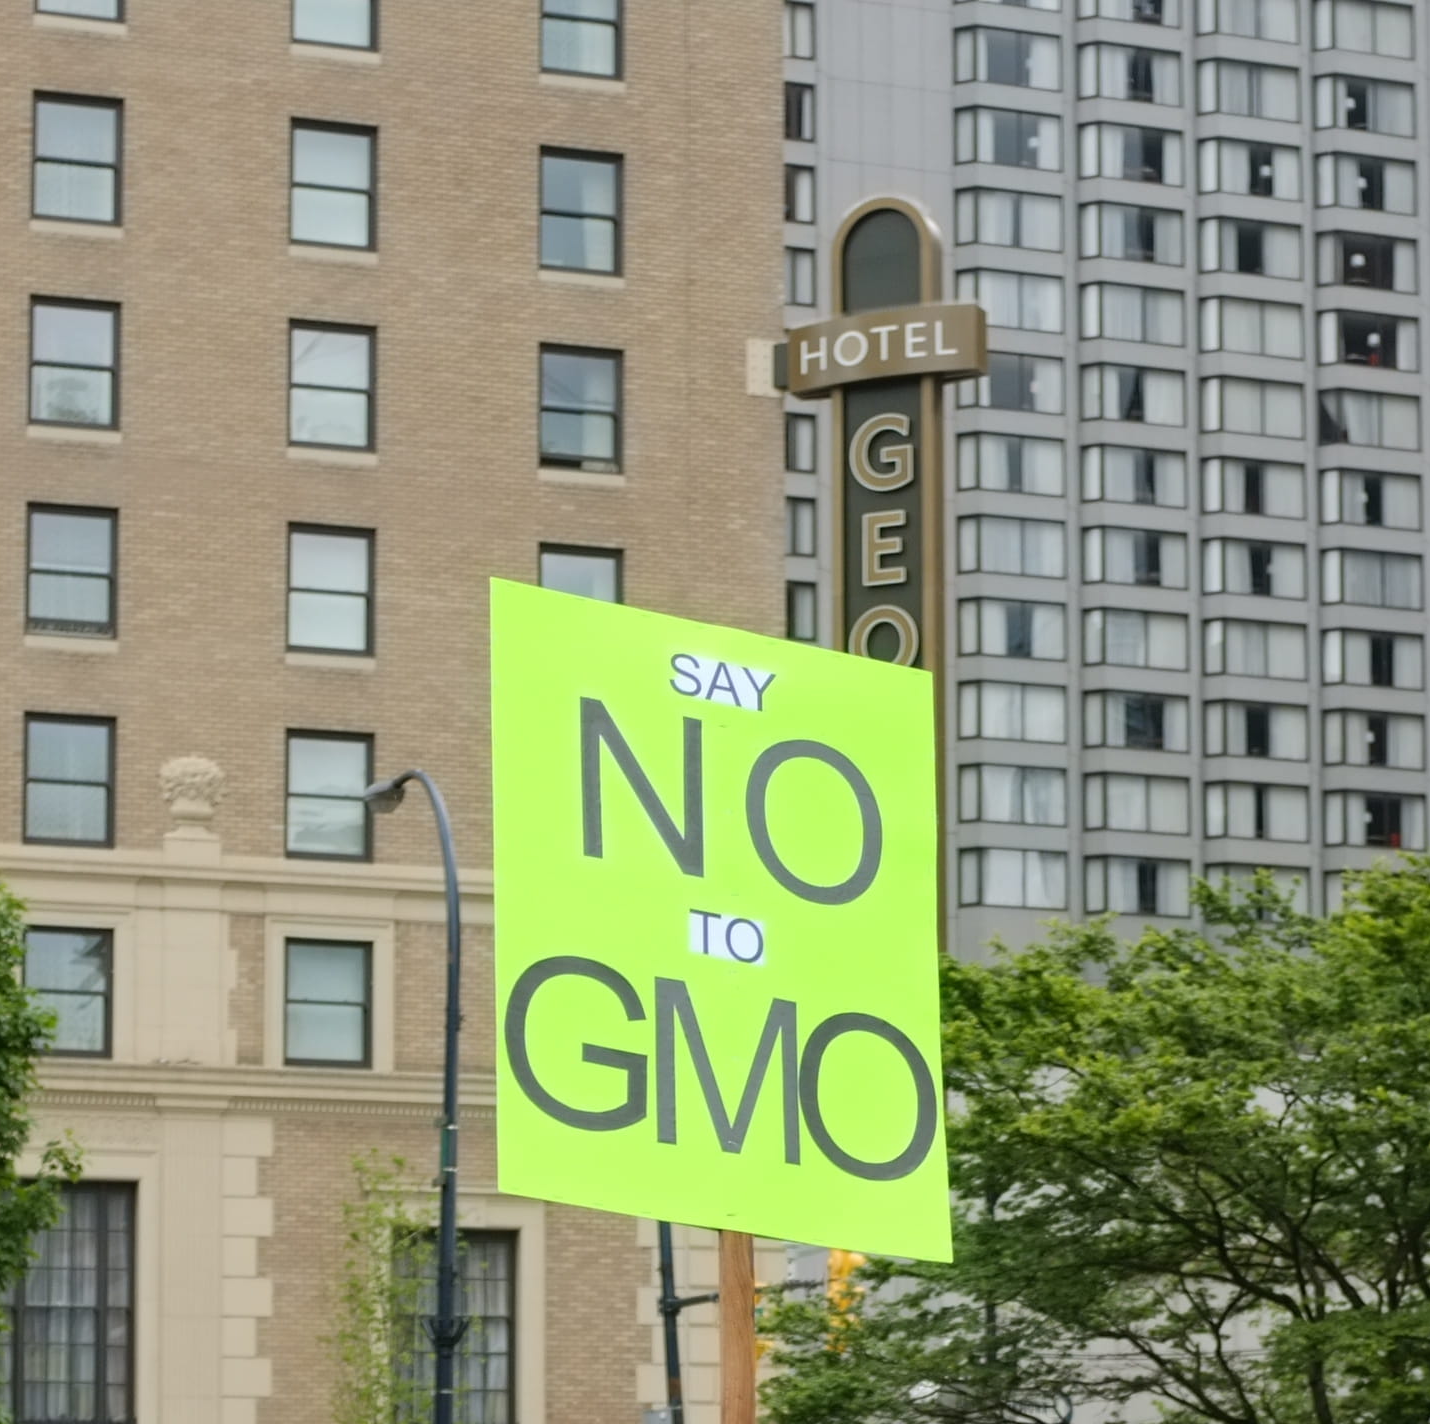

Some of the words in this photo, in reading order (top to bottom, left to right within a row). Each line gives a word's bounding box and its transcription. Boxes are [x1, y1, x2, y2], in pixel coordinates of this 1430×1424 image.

[800, 321, 958, 374] HOTEL
[669, 653, 775, 711] SAY
[579, 696, 882, 905] NO
[689, 909, 764, 963] TO
[505, 956, 937, 1181] GMO
